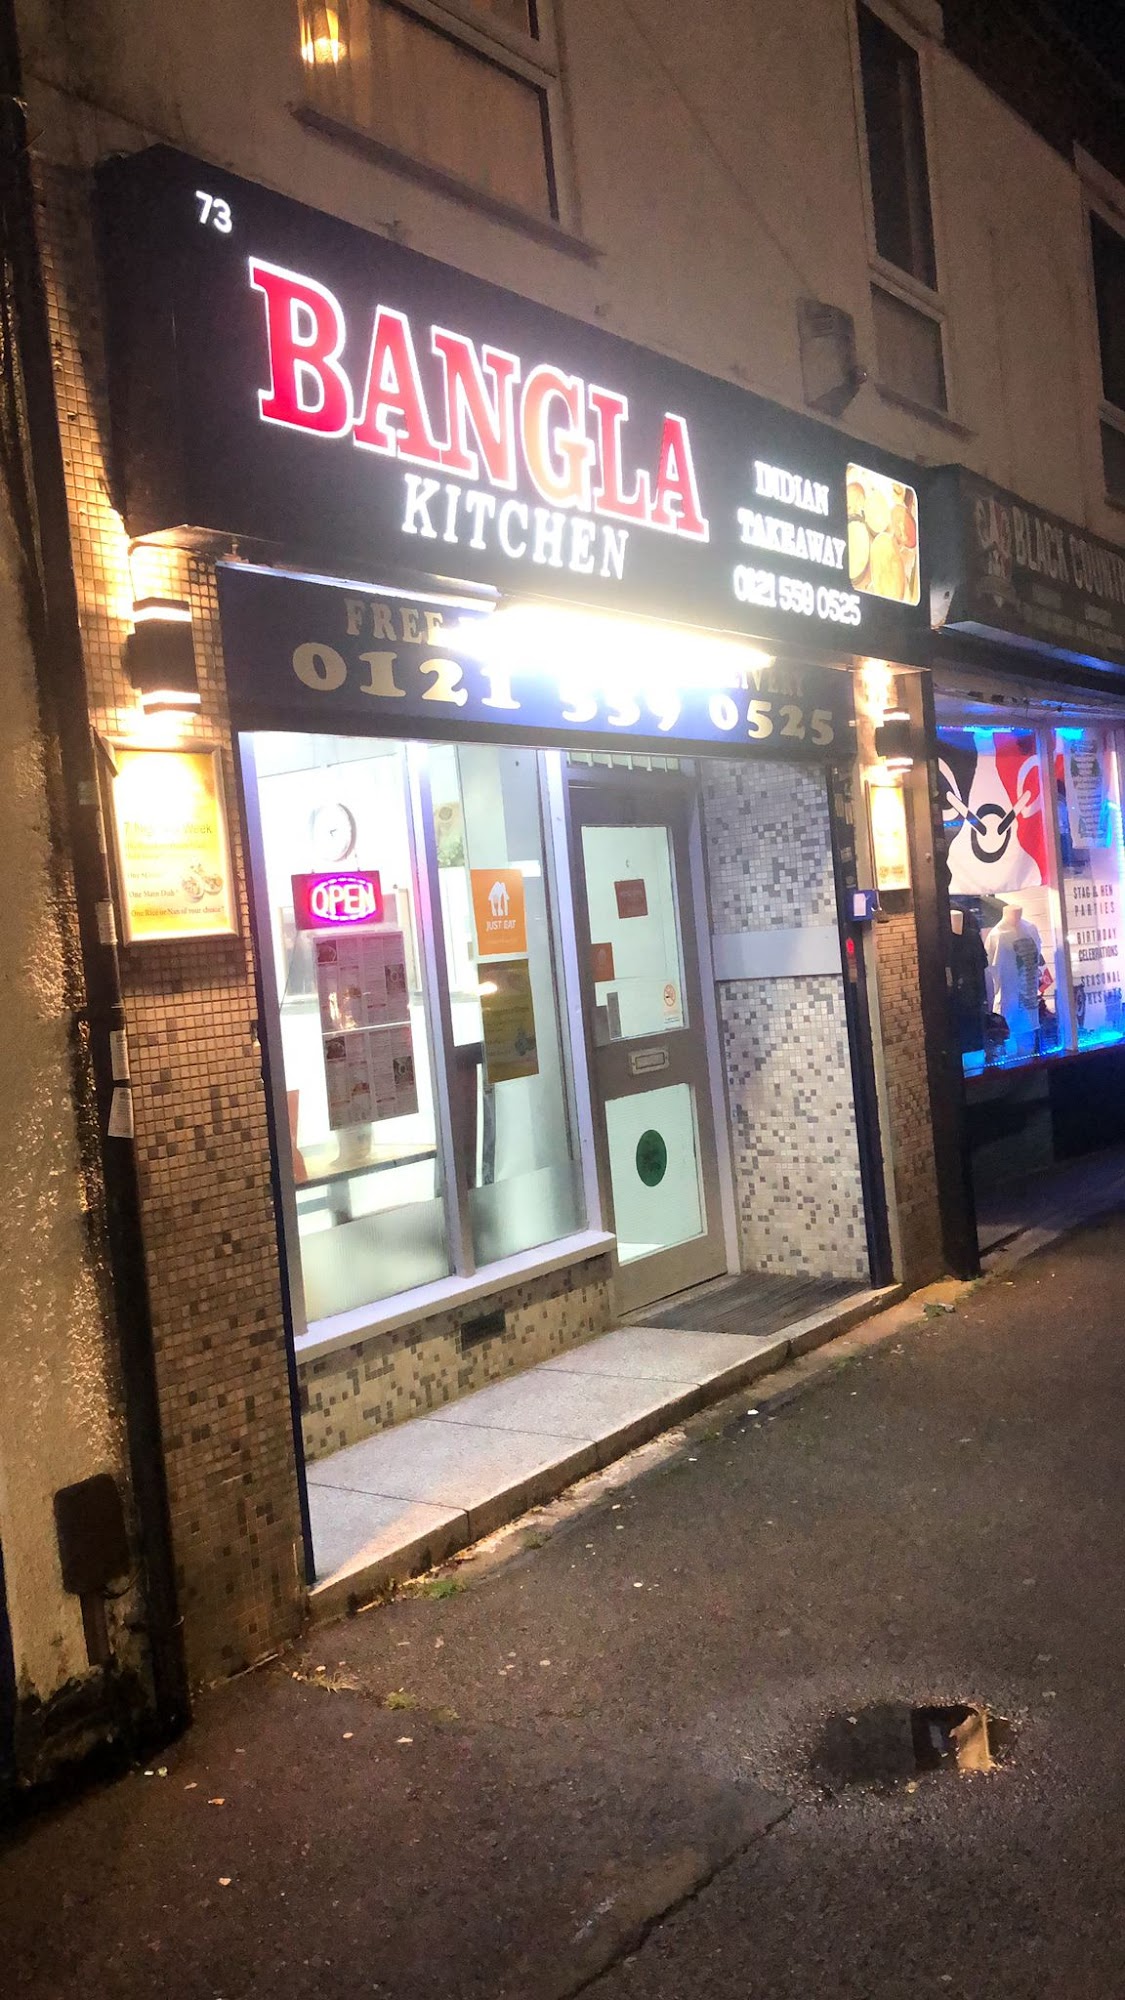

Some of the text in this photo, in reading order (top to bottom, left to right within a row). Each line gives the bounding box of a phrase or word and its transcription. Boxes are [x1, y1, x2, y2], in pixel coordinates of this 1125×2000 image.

[195, 190, 232, 233] 73
[248, 255, 710, 543] BANGLA
[754, 460, 830, 516] INDIAN
[401, 473, 629, 580] KITCHEN
[737, 507, 847, 570] TAKEAWAY
[779, 576, 815, 616] 559
[817, 586, 862, 626] 0525
[293, 642, 521, 710] 0121
[708, 693, 834, 746] 0525
[311, 882, 376, 917] OPEN
[1074, 901, 1116, 917] PARTIES
[486, 919, 516, 931] JUST EAT
[1076, 927, 1117, 944] BIRTHDAY
[1080, 971, 1121, 988] SEASONAL
